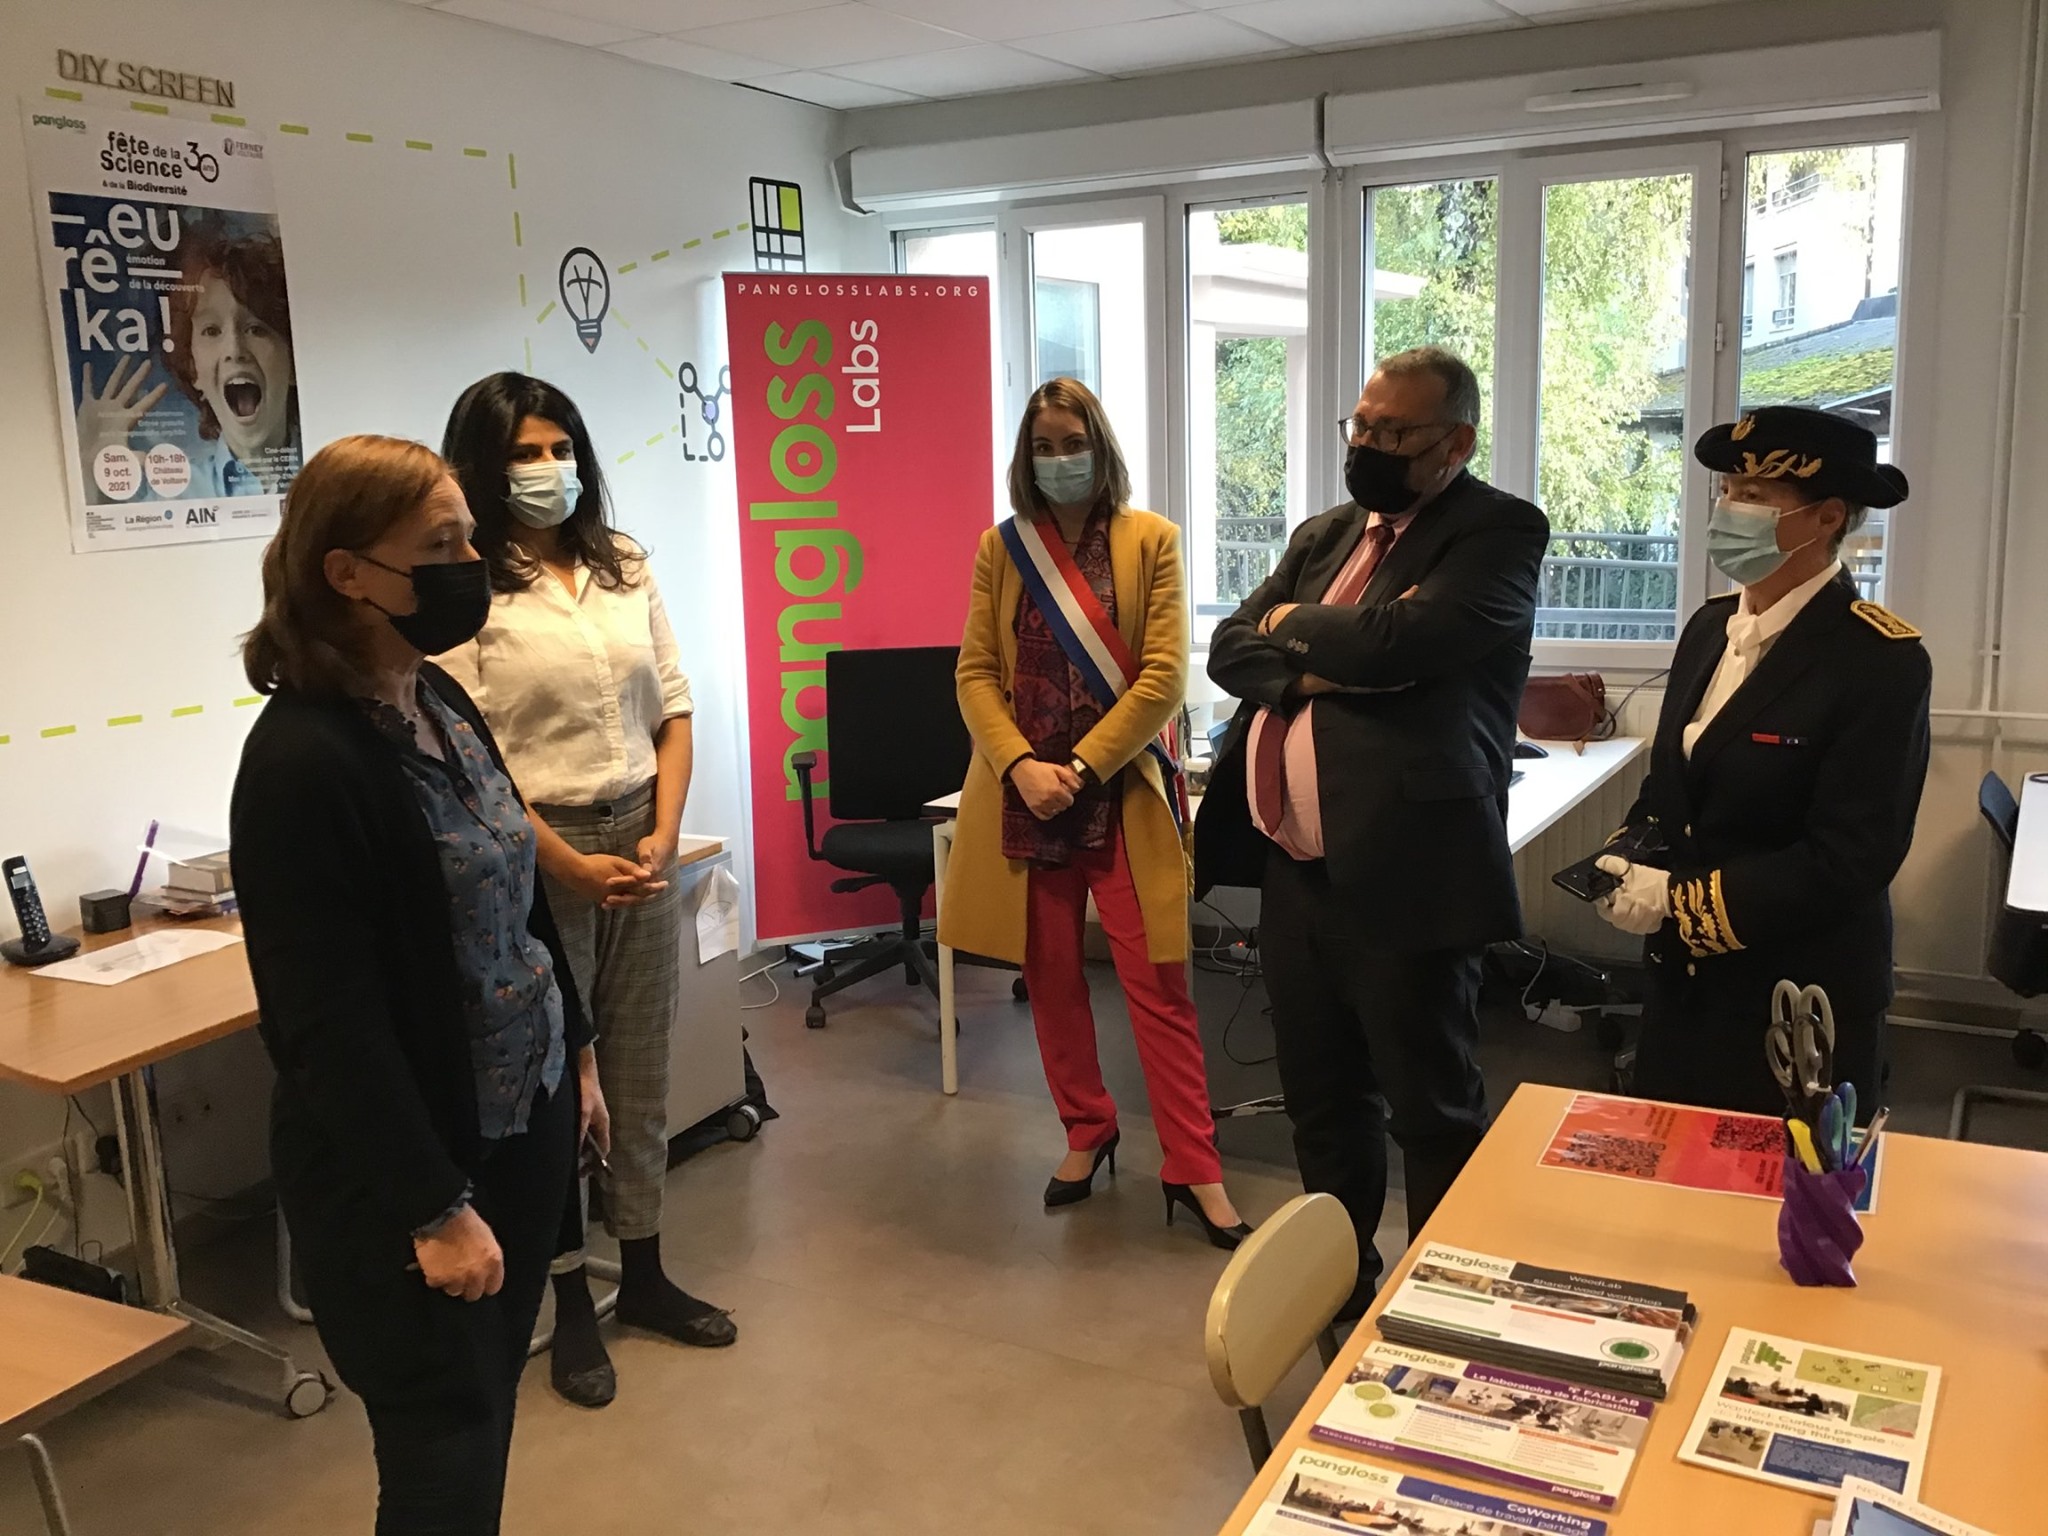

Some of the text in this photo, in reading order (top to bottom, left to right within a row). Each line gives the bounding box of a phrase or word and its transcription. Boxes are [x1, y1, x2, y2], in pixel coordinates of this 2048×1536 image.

[57, 49, 235, 108] DIY SCREEN
[32, 114, 87, 130] pangloss
[107, 131, 181, 160] fête de la
[100, 150, 182, 179] Science
[184, 141, 219, 183] 30
[127, 180, 188, 196] Biodiversité
[107, 202, 180, 251] eu
[126, 253, 166, 266] émotion
[128, 278, 205, 293] de la découverte
[737, 282, 979, 298] PANGLOSSLABS.ORG
[841, 318, 882, 433] Labs
[103, 452, 129, 463] Sam.
[148, 453, 186, 464] 10h-18h
[104, 467, 132, 477] 9 oct.
[108, 482, 131, 492] 2021
[125, 515, 163, 526] La Région
[185, 508, 217, 526] AIN
[1425, 1249, 1509, 1274] pangloss
[1533, 1278, 1663, 1307] Shared wood workshop
[1569, 1274, 1622, 1290] WoodLab
[1374, 1346, 1457, 1370] pangloss
[1598, 1360, 1655, 1376] pangloss
[1472, 1371, 1638, 1415] Le laboratoire de fabrication
[1583, 1389, 1641, 1407] FABLAB
[1734, 1412, 1807, 1437] interesting
[1809, 1429, 1854, 1446] things
[1778, 1414, 1832, 1434] Curious
[1833, 1426, 1887, 1447] people
[1298, 1454, 1391, 1485] pangloss
[1551, 1484, 1601, 1502] pangloss
[1430, 1493, 1590, 1536] Espace de travail partagé
[1506, 1502, 1592, 1530] CoWorking
